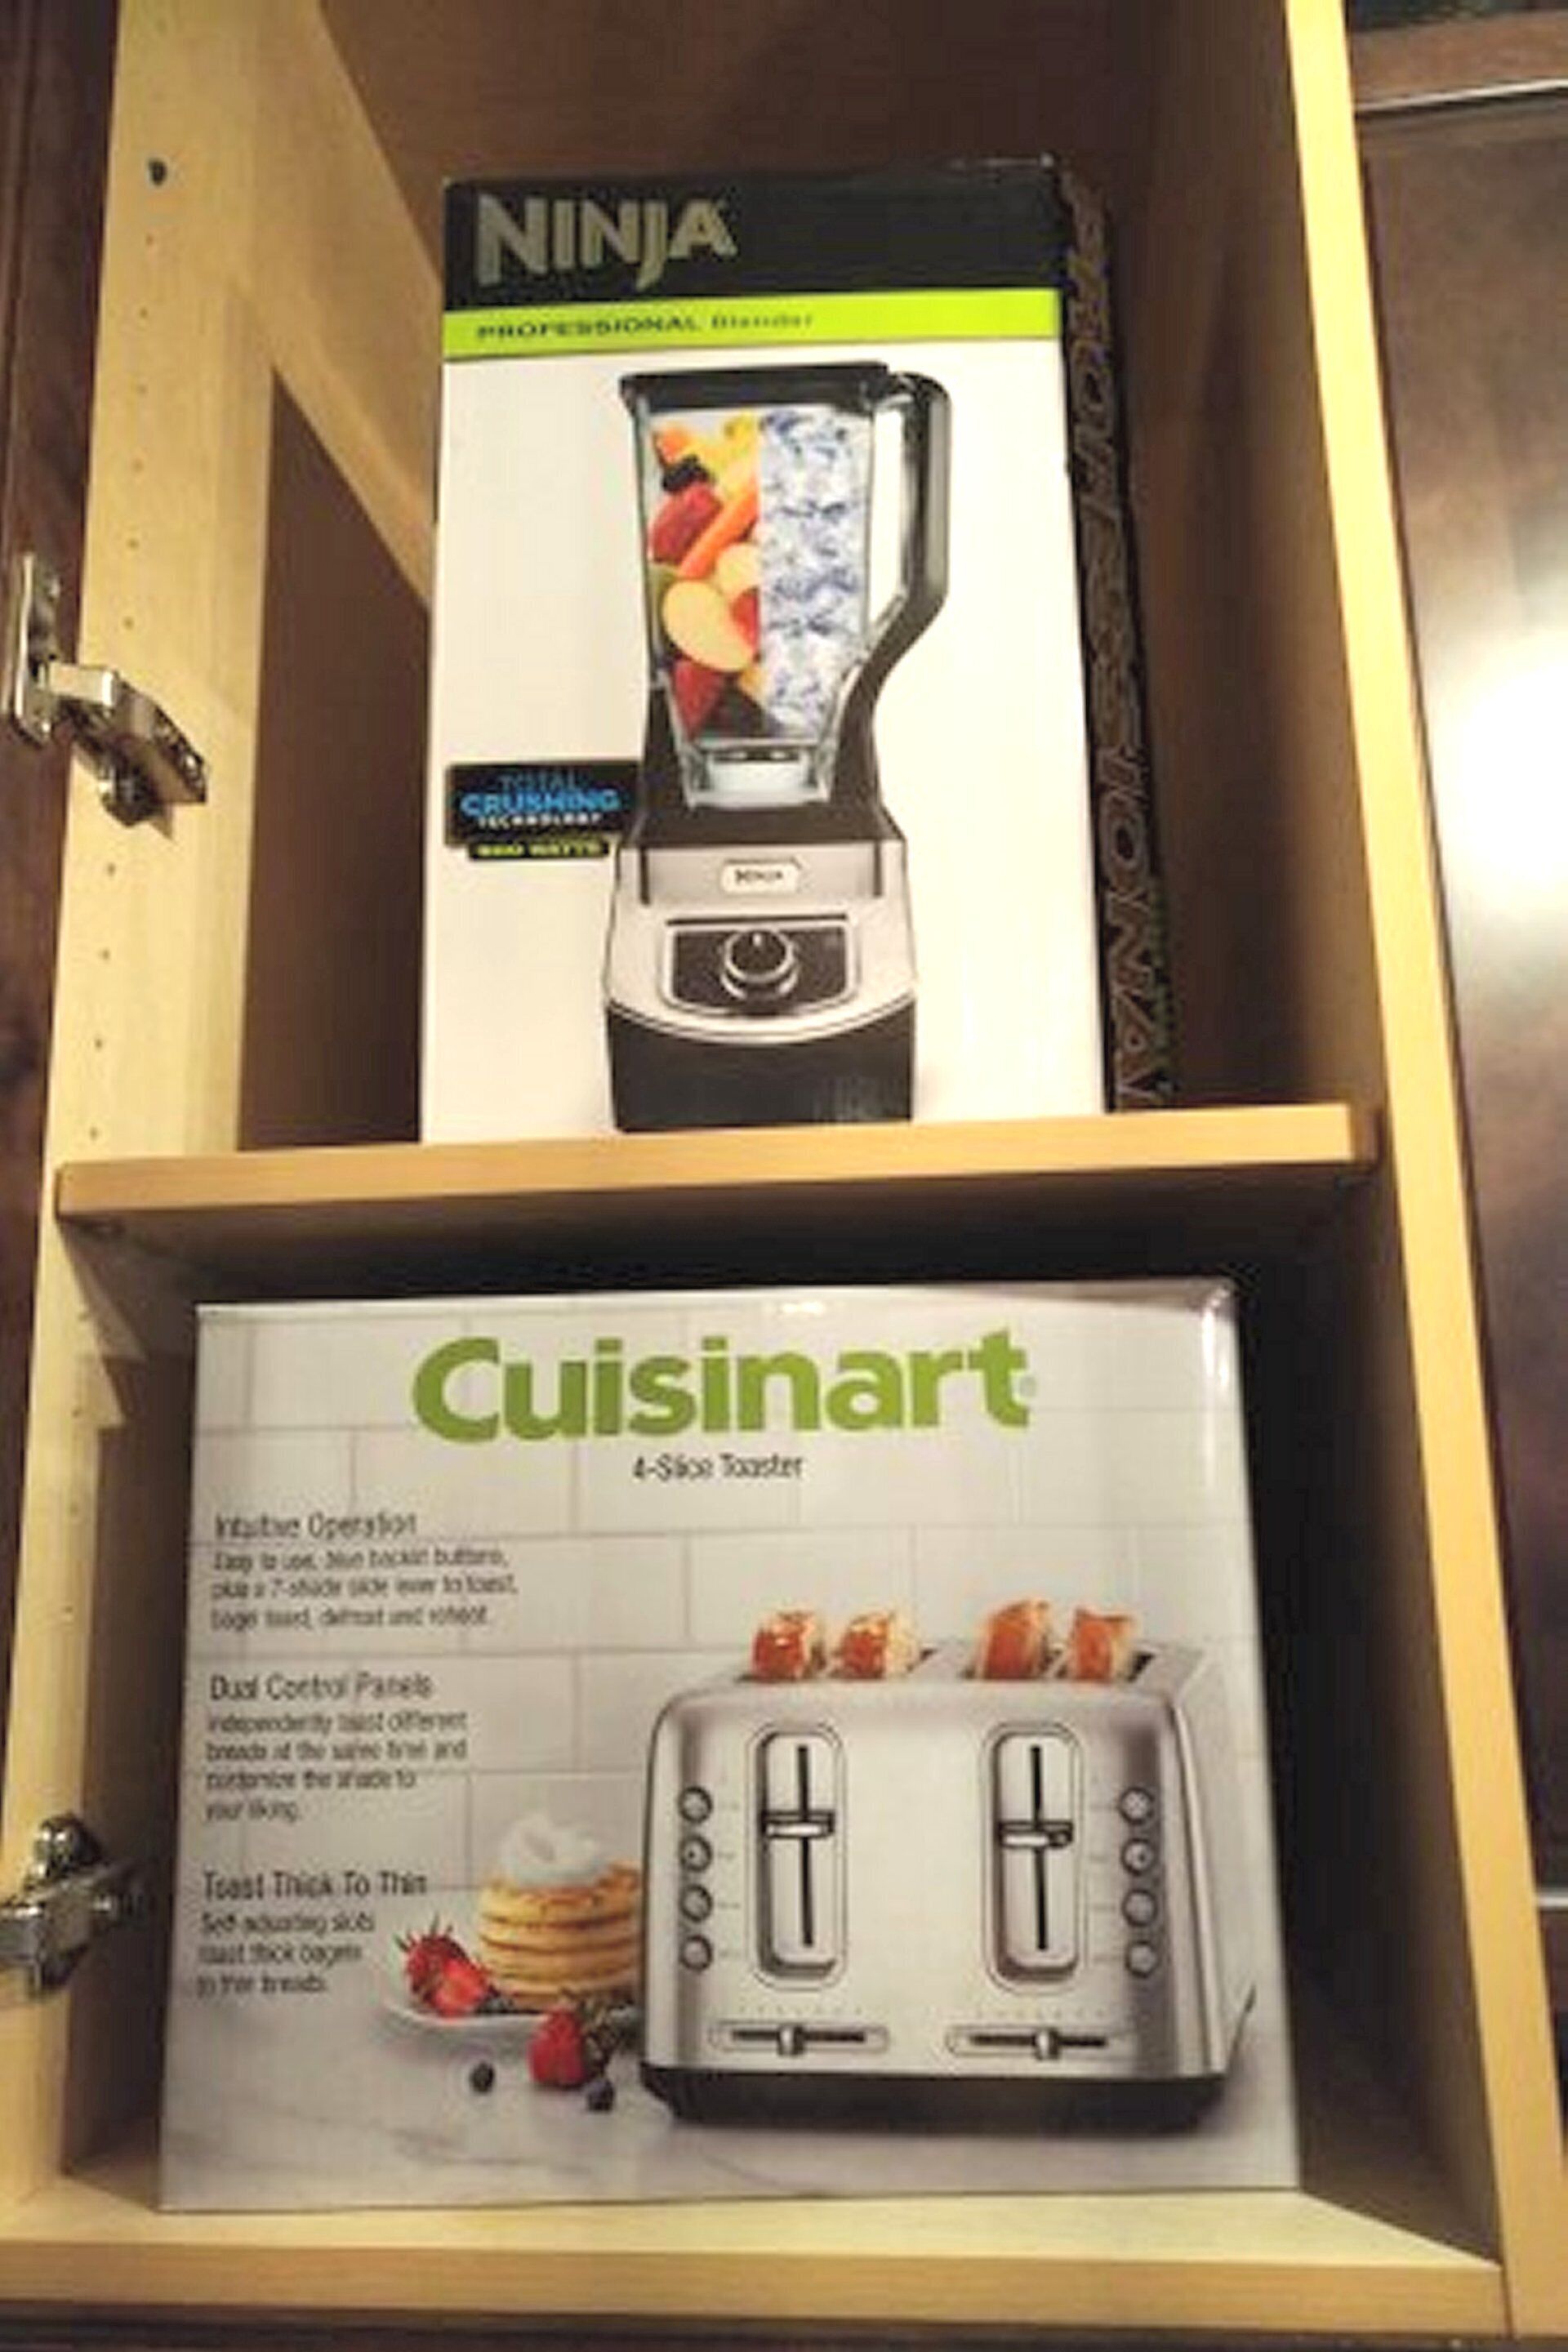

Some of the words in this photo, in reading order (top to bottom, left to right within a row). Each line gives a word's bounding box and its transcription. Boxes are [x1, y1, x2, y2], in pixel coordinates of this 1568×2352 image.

[476, 194, 737, 289] NINJA
[477, 315, 700, 341] PROFESSIONAL
[459, 789, 621, 816] CRUSHING
[412, 1329, 1031, 1444] Cuisinart
[633, 1453, 714, 1482] 4-Slice
[719, 1452, 803, 1479] Toaster
[215, 1512, 301, 1539] Intuitive
[308, 1512, 416, 1540] Operation
[210, 1674, 256, 1700] Dual
[265, 1673, 347, 1700] Control
[354, 1672, 433, 1699] Panels
[204, 1871, 264, 1900] Toast
[274, 1871, 332, 1898] Thick
[344, 1870, 370, 1896] To
[381, 1870, 427, 1895] Thin
